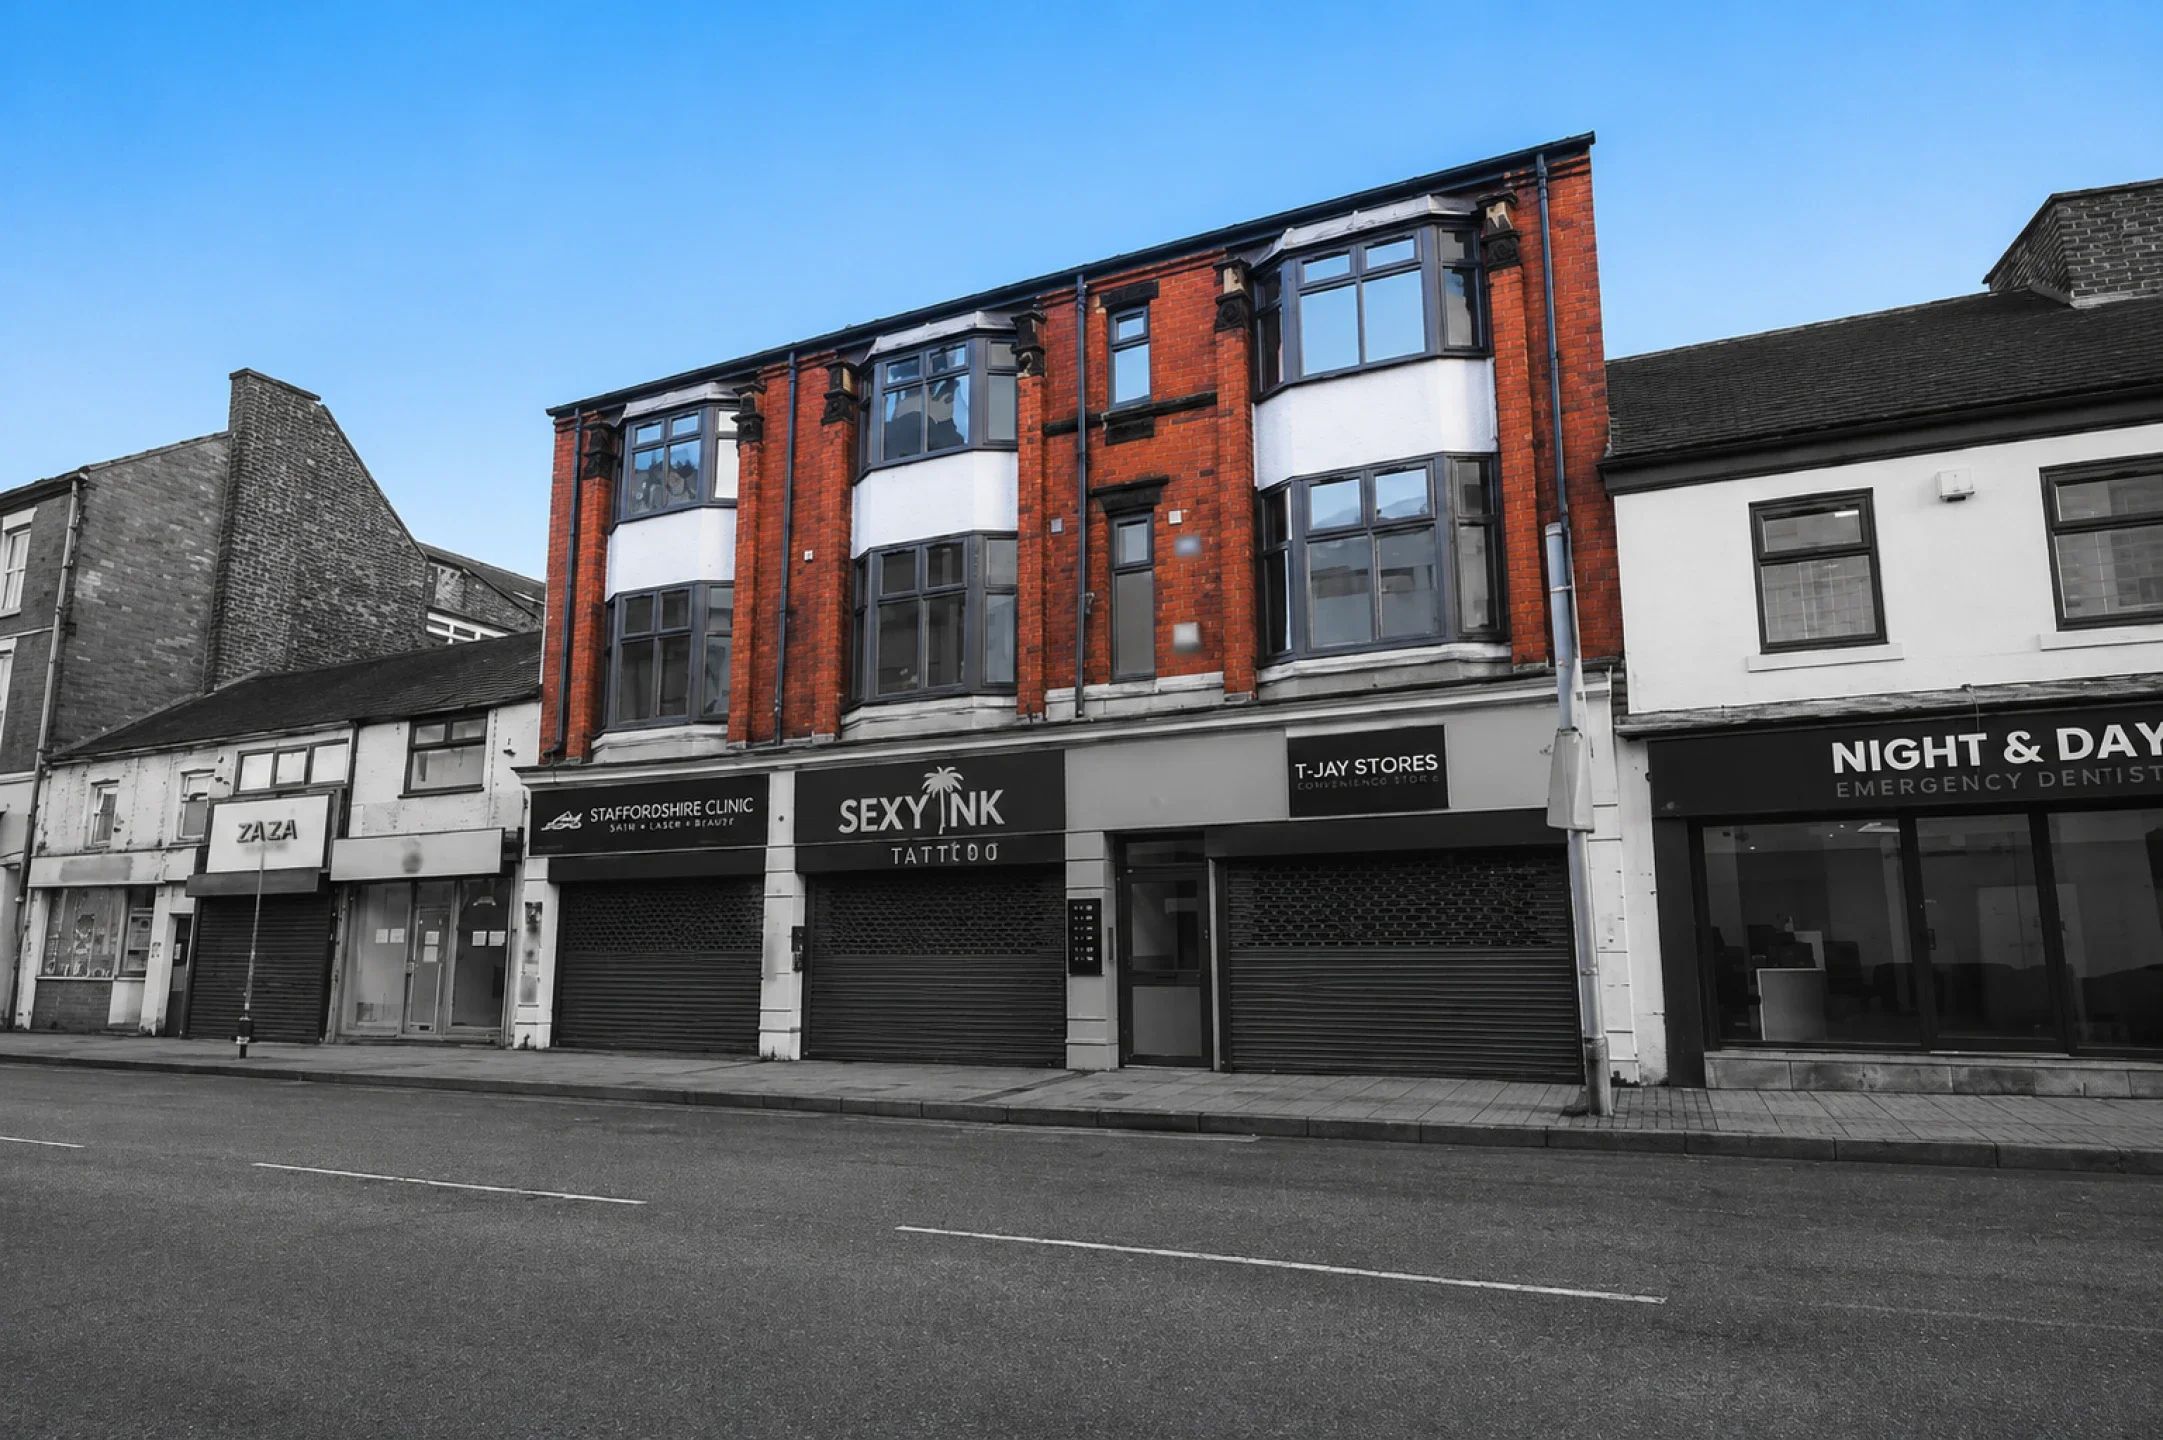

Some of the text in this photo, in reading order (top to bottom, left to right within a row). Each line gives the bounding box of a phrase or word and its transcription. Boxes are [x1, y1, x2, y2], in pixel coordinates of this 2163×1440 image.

[1831, 721, 2163, 774] NIGHT & DAY
[1294, 753, 1439, 780] T-JAY STORES
[1836, 771, 2022, 798] EMERGENCY
[590, 797, 754, 823] STAFFORDSHIRE CLINIC
[838, 793, 930, 834] SEXY
[236, 819, 298, 843] ZAZA
